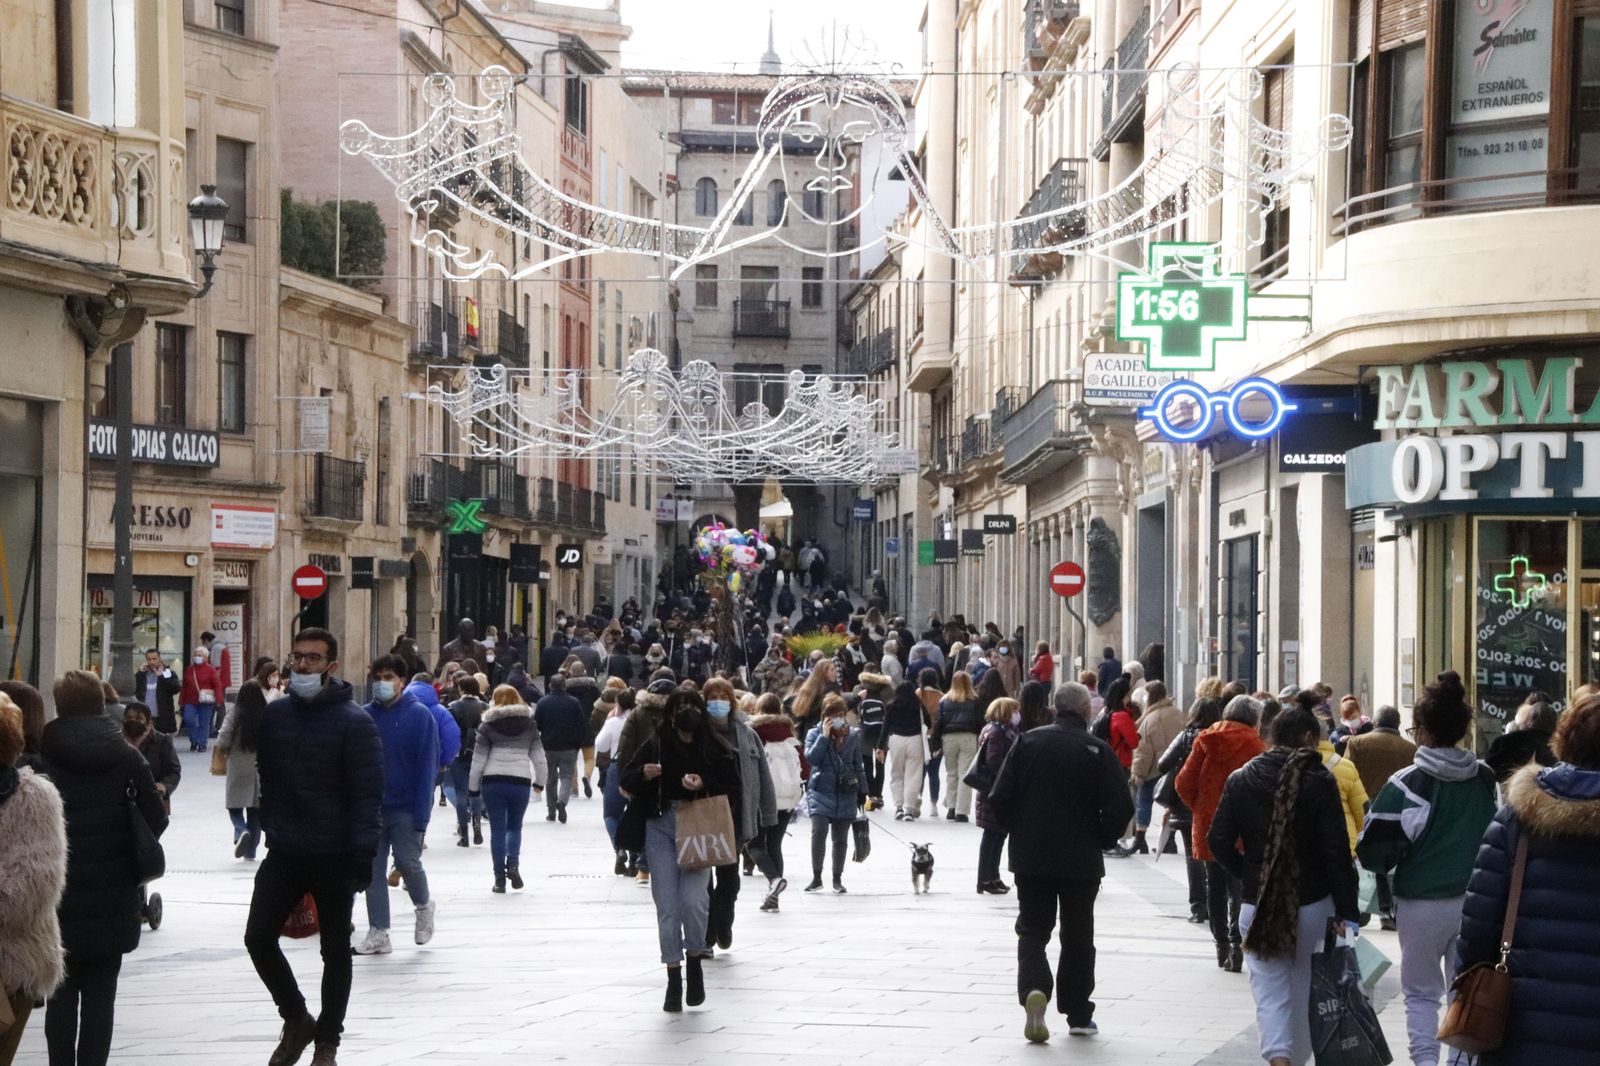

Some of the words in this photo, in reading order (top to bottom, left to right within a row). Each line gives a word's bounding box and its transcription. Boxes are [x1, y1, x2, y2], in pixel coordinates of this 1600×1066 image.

[1478, 77, 1528, 94] ESPAÑOL
[1461, 91, 1544, 112] EXTRANJEROS
[1483, 143, 1501, 155] 923
[1504, 142, 1515, 153] 21
[1518, 140, 1528, 151] 18
[1531, 138, 1544, 150] 08
[1101, 374, 1157, 388] GALILEO
[172, 432, 217, 464] CALCO
[560, 549, 581, 564] JD
[225, 563, 248, 578] CALCO
[677, 832, 734, 865] ZARA
